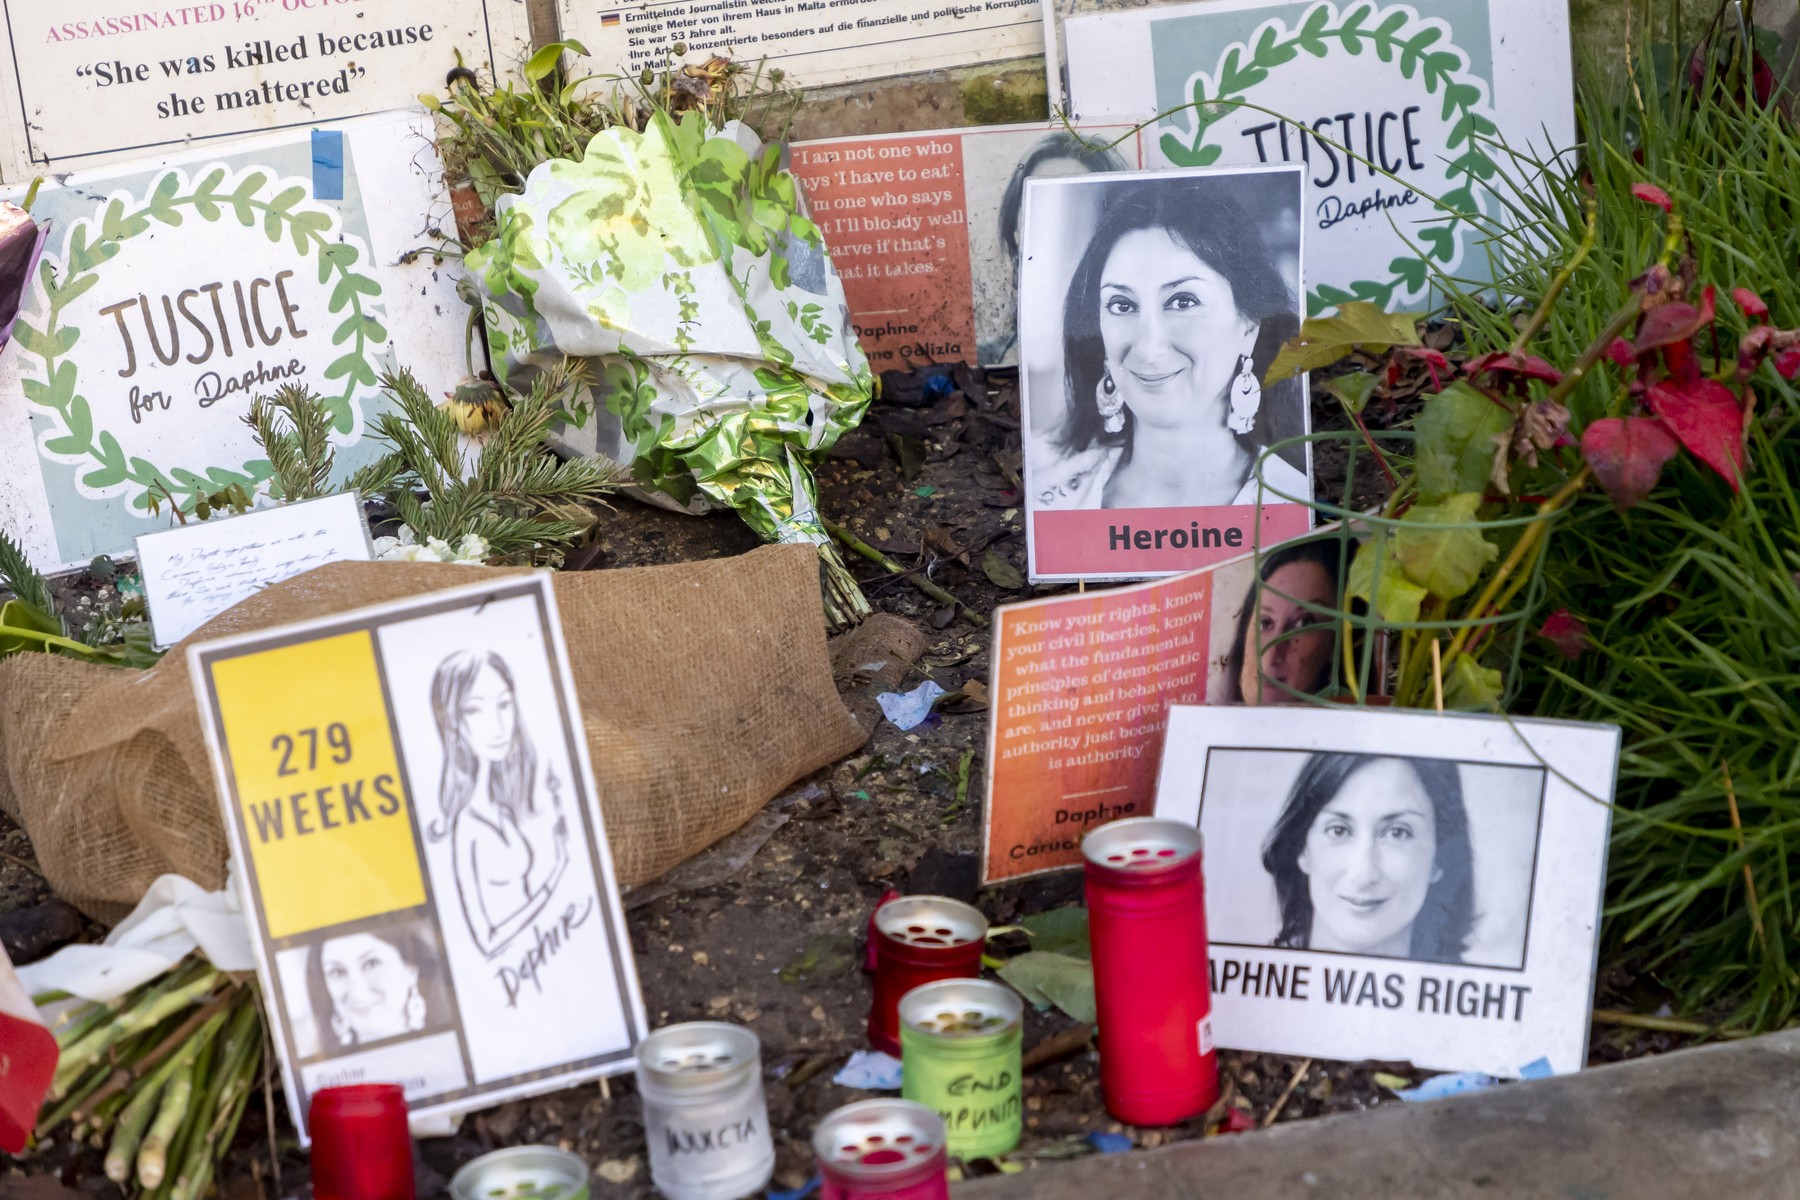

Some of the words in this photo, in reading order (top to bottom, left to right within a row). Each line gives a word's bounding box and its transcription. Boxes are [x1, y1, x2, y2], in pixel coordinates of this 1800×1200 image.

[46, 3, 225, 42] ASSASSINATED
[625, 7, 686, 22] Ermittelnde
[689, 0, 747, 14] Journalistin
[627, 23, 663, 34] wenige
[667, 18, 698, 29] Meter
[701, 16, 719, 24] von
[723, 12, 752, 21] ihrem
[756, 8, 781, 17] Haus
[784, 5, 794, 13] in
[797, 1, 825, 11] Malta
[628, 37, 645, 47] Sie
[649, 35, 667, 43] war
[671, 31, 685, 41] 53
[689, 28, 716, 39] Jahre
[719, 25, 736, 34] alt.
[629, 49, 651, 59] Ihre
[689, 35, 758, 51] konzentrierte
[761, 27, 815, 41] besonders
[818, 23, 834, 33] auf
[837, 21, 853, 31] die
[856, 14, 908, 28] finanzielle
[911, 10, 930, 20] und
[933, 4, 982, 19] politische
[76, 60, 150, 87] "She
[158, 54, 216, 78] was
[224, 35, 309, 69] killed
[316, 23, 434, 57] because
[631, 63, 641, 71] in
[157, 93, 206, 119] she
[215, 66, 366, 111] mattered"
[812, 151, 840, 164] am
[845, 146, 875, 160] not
[879, 145, 912, 159] one
[915, 140, 953, 156] who
[804, 173, 831, 191] ys
[850, 170, 894, 184] have
[898, 166, 917, 181] to
[834, 196, 866, 209] one
[870, 191, 908, 207] who
[911, 189, 953, 206] says
[1316, 188, 1419, 229] Daphne
[835, 217, 860, 233] I'll
[863, 216, 923, 233] bloody
[927, 209, 964, 226] well
[829, 243, 872, 256] arve
[877, 238, 891, 253] if
[893, 236, 946, 252] that's
[838, 263, 863, 279] at
[866, 263, 880, 277] it
[98, 269, 308, 378] JUSTICE
[852, 321, 918, 341] Daphne
[129, 385, 172, 424] for
[194, 358, 306, 408] Daphne
[1109, 521, 1243, 550] Heroine
[1065, 611, 1106, 630] your
[1109, 602, 1161, 623] rights,
[1164, 589, 1206, 610] know
[1006, 641, 1045, 660] your
[1048, 632, 1085, 651] civil
[1089, 624, 1160, 645] liberties,
[1163, 609, 1206, 630] know
[1015, 657, 1057, 676] what
[1060, 653, 1090, 668] the
[1093, 631, 1196, 665] fundamental
[1006, 673, 1089, 700] principles
[1092, 669, 1111, 684] of
[1113, 651, 1201, 679] democratic
[1007, 697, 1080, 718] thinking
[1083, 689, 1114, 706] and
[1119, 672, 1197, 699] behaviour
[1004, 724, 1036, 739] are,
[1040, 715, 1072, 731] and
[1075, 709, 1124, 726] never
[1126, 702, 1160, 721] give
[1182, 692, 1198, 703] to
[271, 722, 353, 777] 279
[1002, 734, 1081, 759] authority
[1083, 730, 1116, 748] just
[1120, 721, 1166, 739] becau
[1048, 757, 1063, 770] is
[249, 774, 401, 844] WEEKS
[1055, 801, 1136, 825] Daphne
[1009, 839, 1074, 860] Carua
[494, 896, 593, 1009] Daphne
[1208, 957, 1312, 1000] PHNE
[1323, 967, 1406, 1010] WAS
[1417, 976, 1533, 1022] RIGHT
